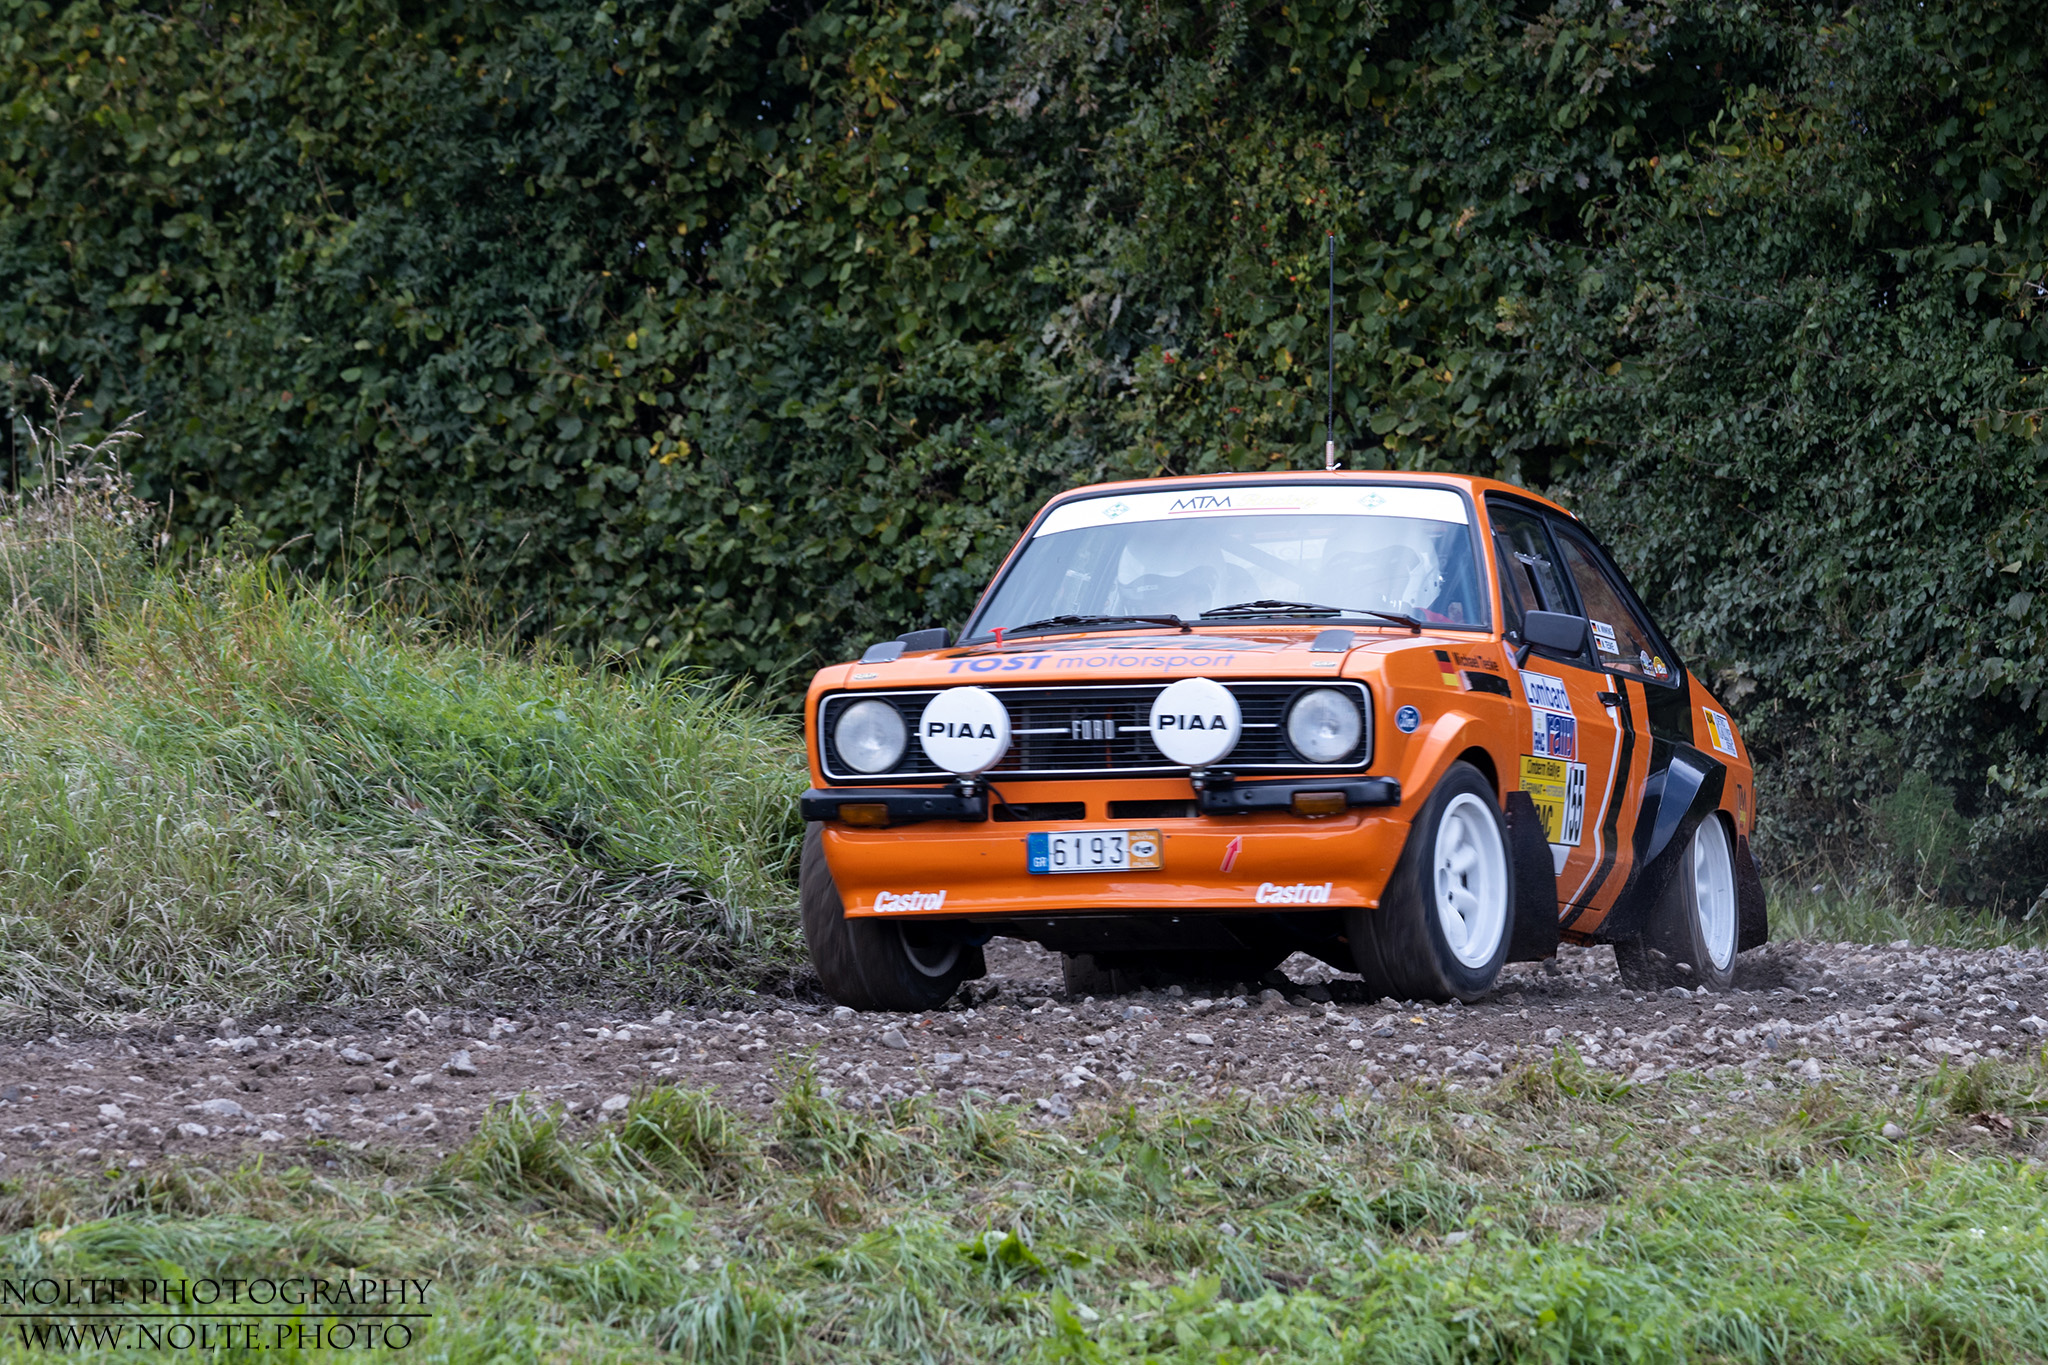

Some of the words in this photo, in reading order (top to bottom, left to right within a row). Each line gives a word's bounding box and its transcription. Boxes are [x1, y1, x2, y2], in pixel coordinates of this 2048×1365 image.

[1170, 496, 1232, 511] MTM
[949, 655, 1053, 674] TOST
[1056, 653, 1235, 672] motorsport
[1520, 673, 1571, 711] Lombard
[928, 721, 997, 739] PIAA
[1072, 719, 1115, 740] FORD
[1157, 714, 1228, 730] PIAA
[1564, 767, 1584, 842] 155
[1053, 836, 1123, 866] 6193
[1033, 857, 1047, 867] GR
[873, 890, 947, 912] Castrol
[1255, 882, 1333, 904] Castrol
